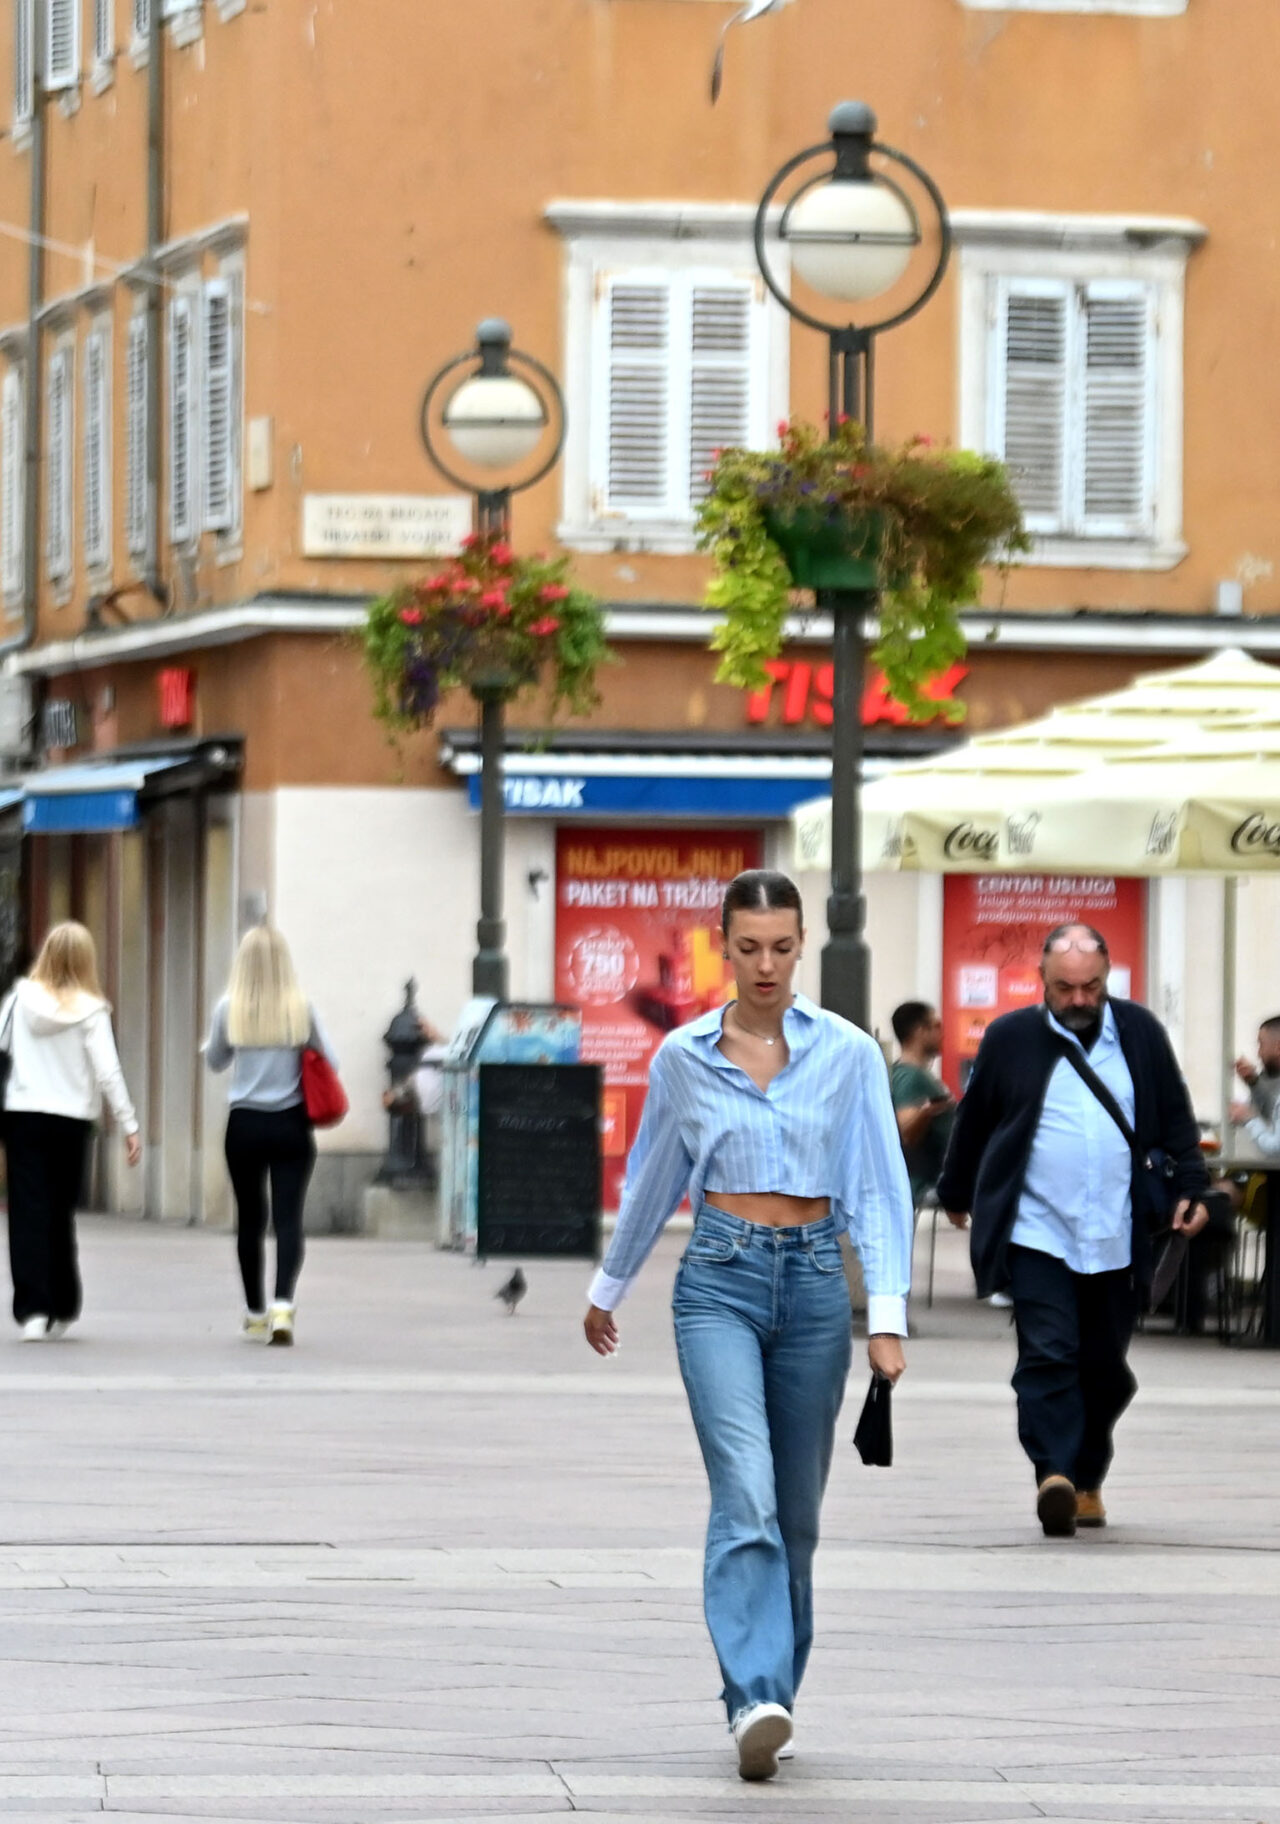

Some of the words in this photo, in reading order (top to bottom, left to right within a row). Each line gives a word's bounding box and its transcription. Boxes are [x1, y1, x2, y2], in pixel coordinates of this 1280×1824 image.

[567, 880, 630, 907] PAKET
[632, 881, 659, 907] NA
[977, 876, 1044, 894] CENTAR
[1048, 877, 1117, 896] USLUGA
